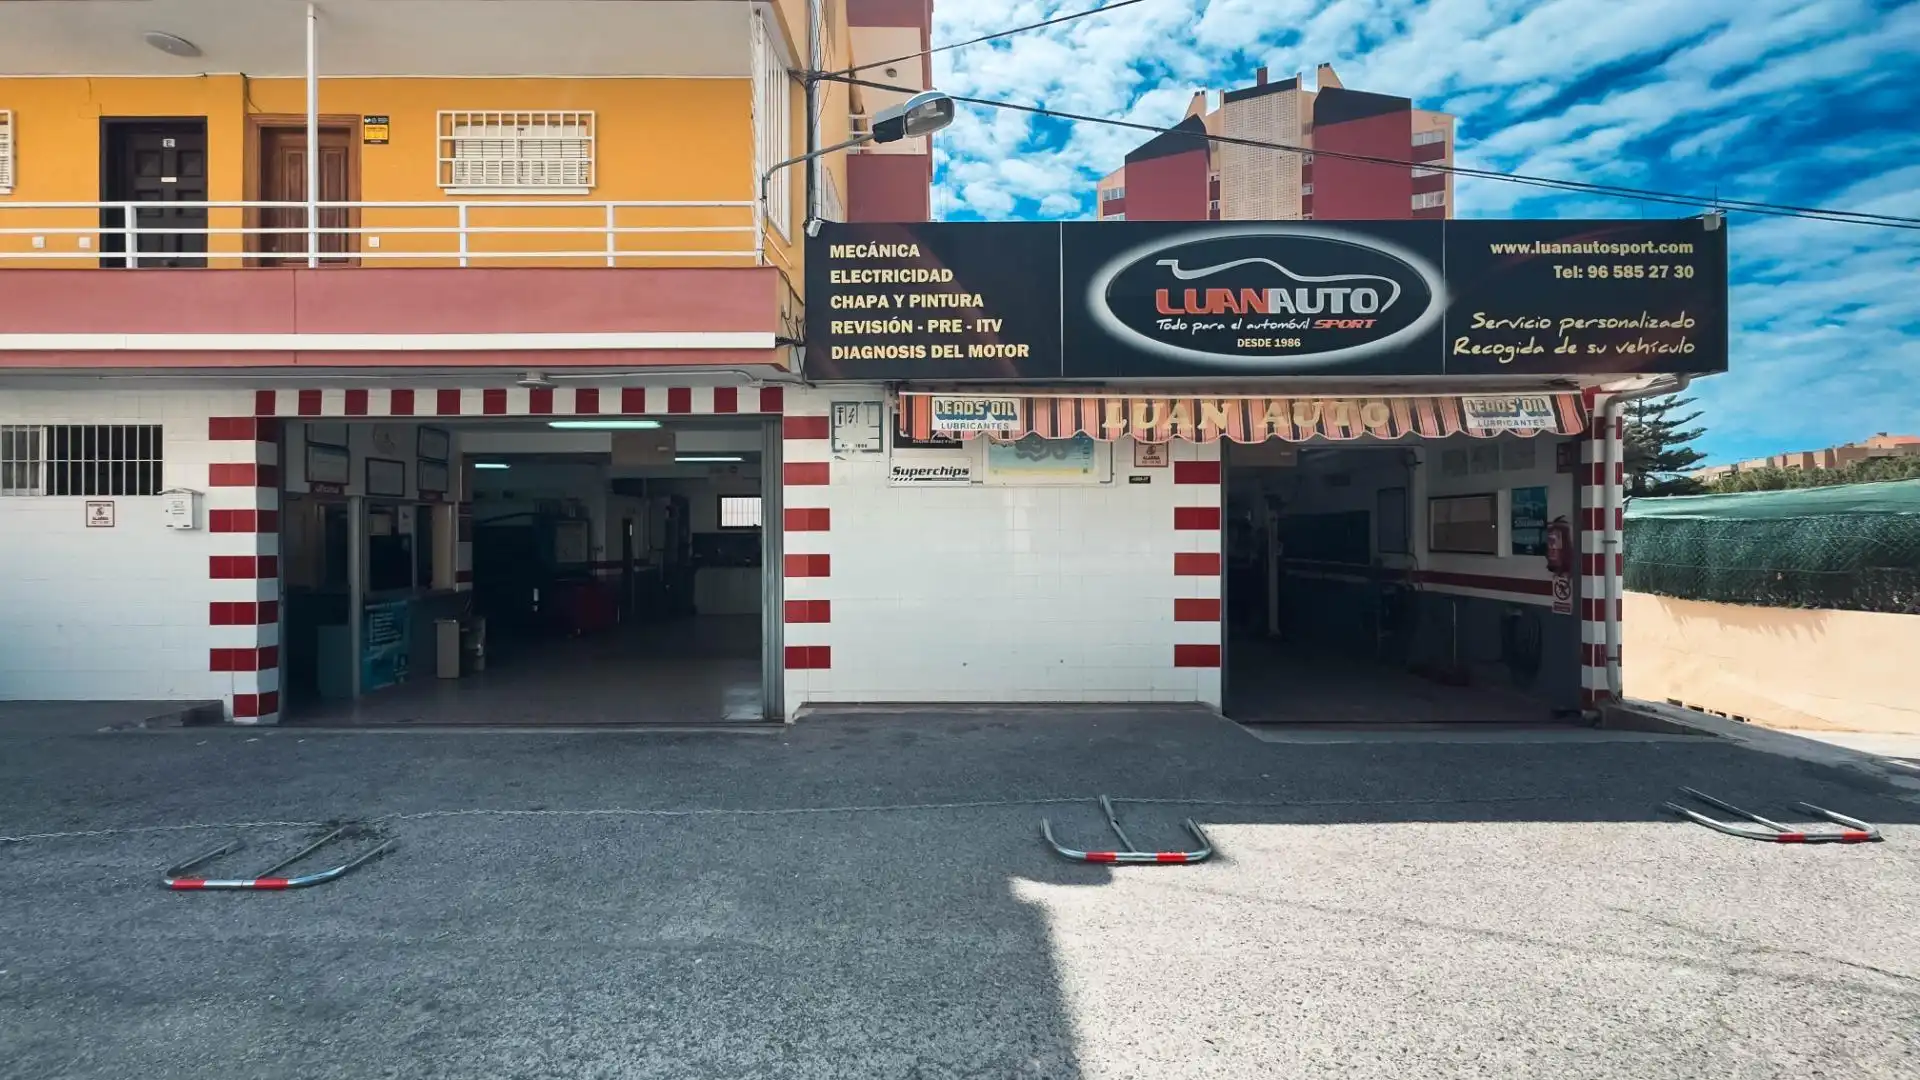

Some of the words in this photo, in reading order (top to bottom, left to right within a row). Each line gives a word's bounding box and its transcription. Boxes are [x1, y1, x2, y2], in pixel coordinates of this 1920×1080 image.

[830, 241, 920, 258] MECÁNICA
[1490, 241, 1694, 256] www.luanautosport.com
[830, 268, 953, 284] ELECTRICIDAD
[1554, 265, 1583, 279] Tel:
[1588, 265, 1609, 279] 96
[1613, 265, 1644, 279] 585
[1648, 265, 1668, 279] 27
[1673, 265, 1694, 279] 30
[830, 294, 889, 309] CHAPA
[893, 294, 906, 308] Y
[909, 293, 984, 308] PINTURA
[831, 316, 913, 334] REVISIÓN
[927, 319, 963, 333] PRE
[976, 318, 1003, 333] ITV
[1156, 318, 1188, 331] Todo
[1192, 322, 1226, 335] para
[1230, 318, 1242, 330] el
[1246, 318, 1310, 331] automóvil
[1312, 319, 1377, 329] SPORT
[1470, 312, 1551, 330] Servicio
[1558, 310, 1695, 337] personalizado
[1237, 338, 1271, 348] DESDE
[1274, 338, 1301, 348] 1986
[1453, 336, 1544, 364] Recogida
[1554, 337, 1578, 355] de
[1587, 343, 1606, 355] su
[1615, 336, 1695, 355] vehículo
[831, 345, 926, 360] DIAGNOSIS
[931, 344, 963, 358] DEL
[968, 344, 1030, 358] MOTOR
[1101, 401, 1233, 430] LUAN
[1256, 401, 1391, 429] AUTO
[1477, 419, 1546, 427] LUBRICANTES
[941, 422, 1009, 430] LUBRICANTES
[892, 466, 970, 477] Superchips
